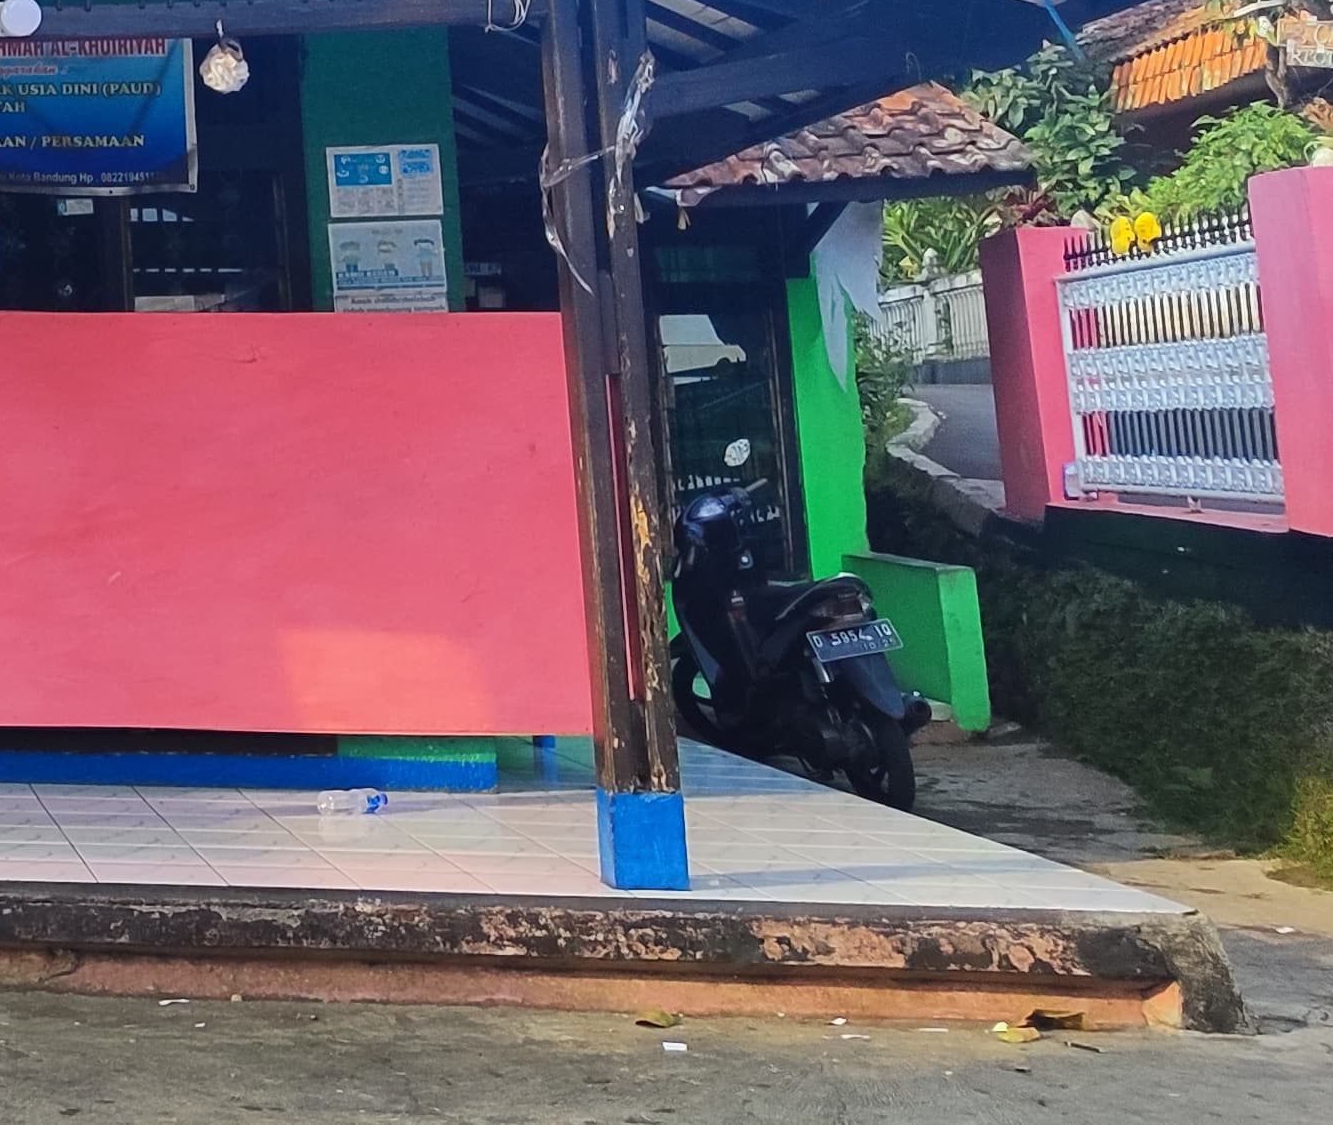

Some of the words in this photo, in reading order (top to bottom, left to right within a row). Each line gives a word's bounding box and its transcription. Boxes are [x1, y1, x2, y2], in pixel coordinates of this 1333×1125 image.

[18, 83, 57, 96] USIA
[62, 83, 98, 95] DINI
[102, 82, 162, 97] (PAUD)
[41, 135, 145, 148] PERSAMAAN
[33, 171, 77, 185] Bandung
[79, 171, 93, 184] Hp
